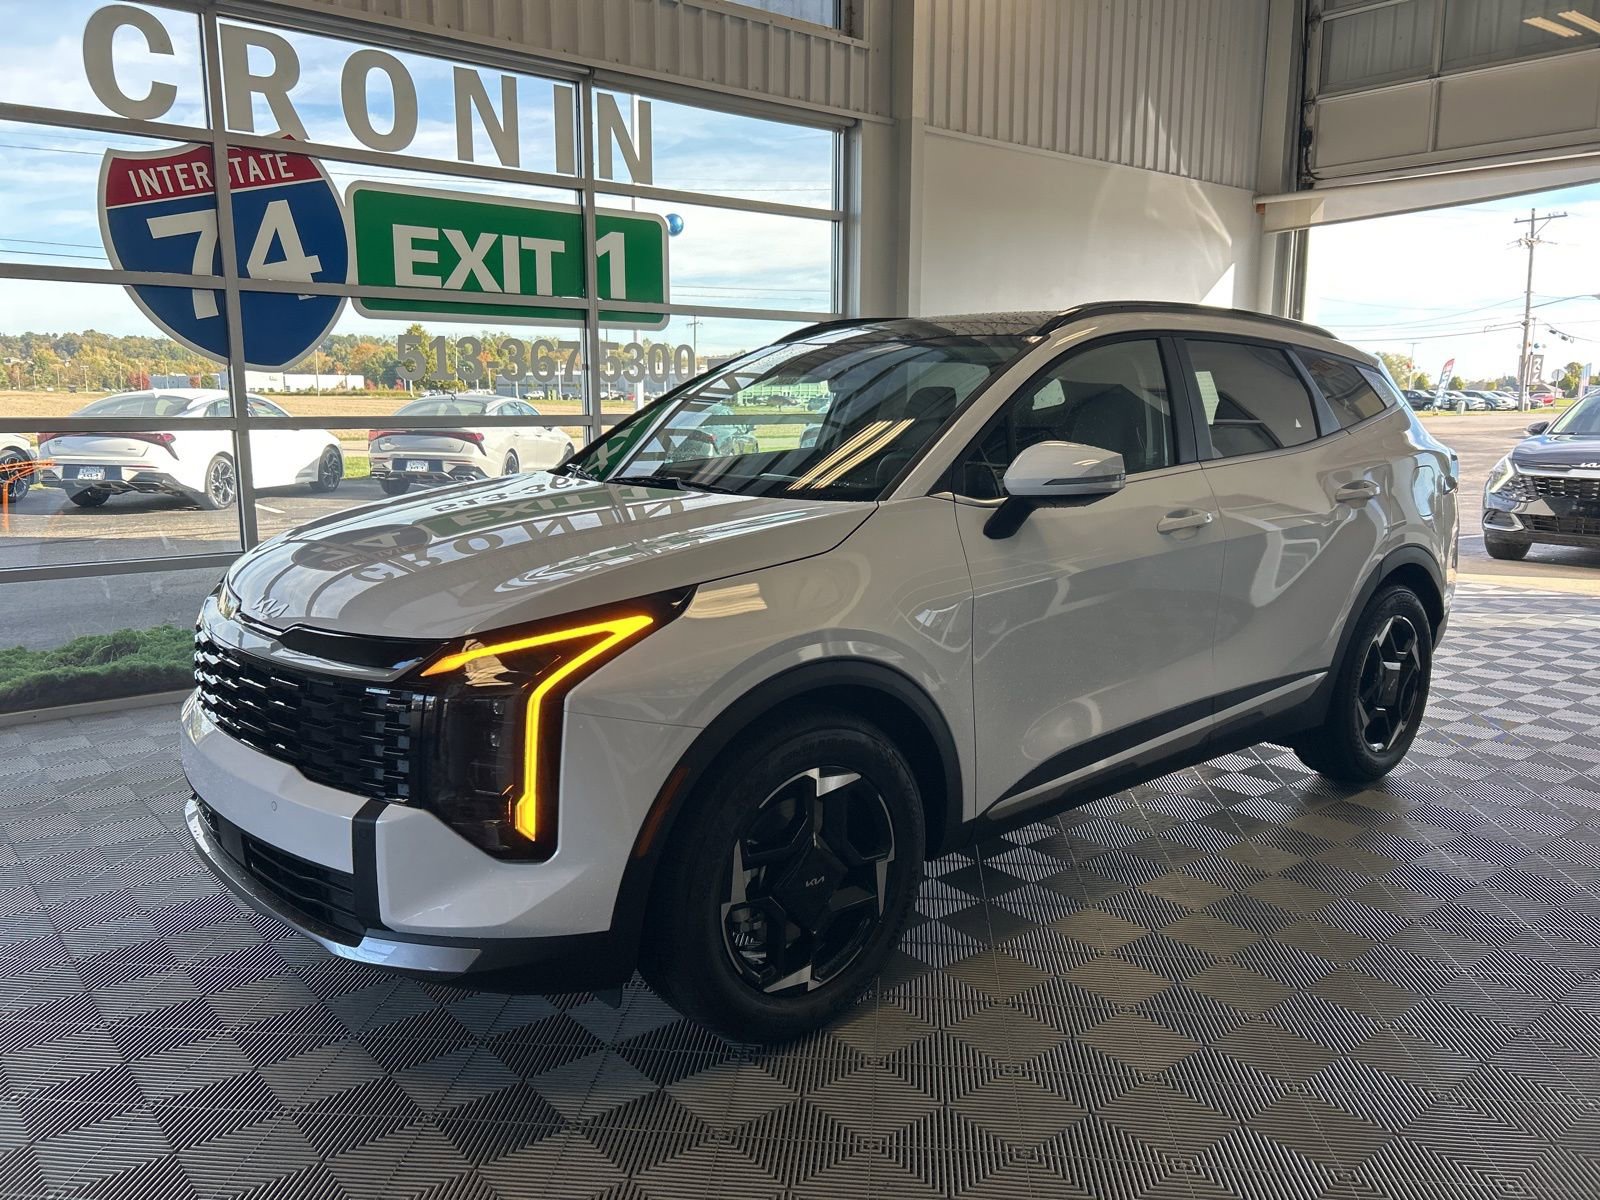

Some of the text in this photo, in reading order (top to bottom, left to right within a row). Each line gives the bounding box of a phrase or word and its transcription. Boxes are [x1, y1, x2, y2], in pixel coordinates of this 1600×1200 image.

[82, 5, 653, 186] CRONIN
[128, 153, 294, 198] INTERTATE
[147, 199, 323, 320] 74
[392, 223, 627, 300] EXIT 1
